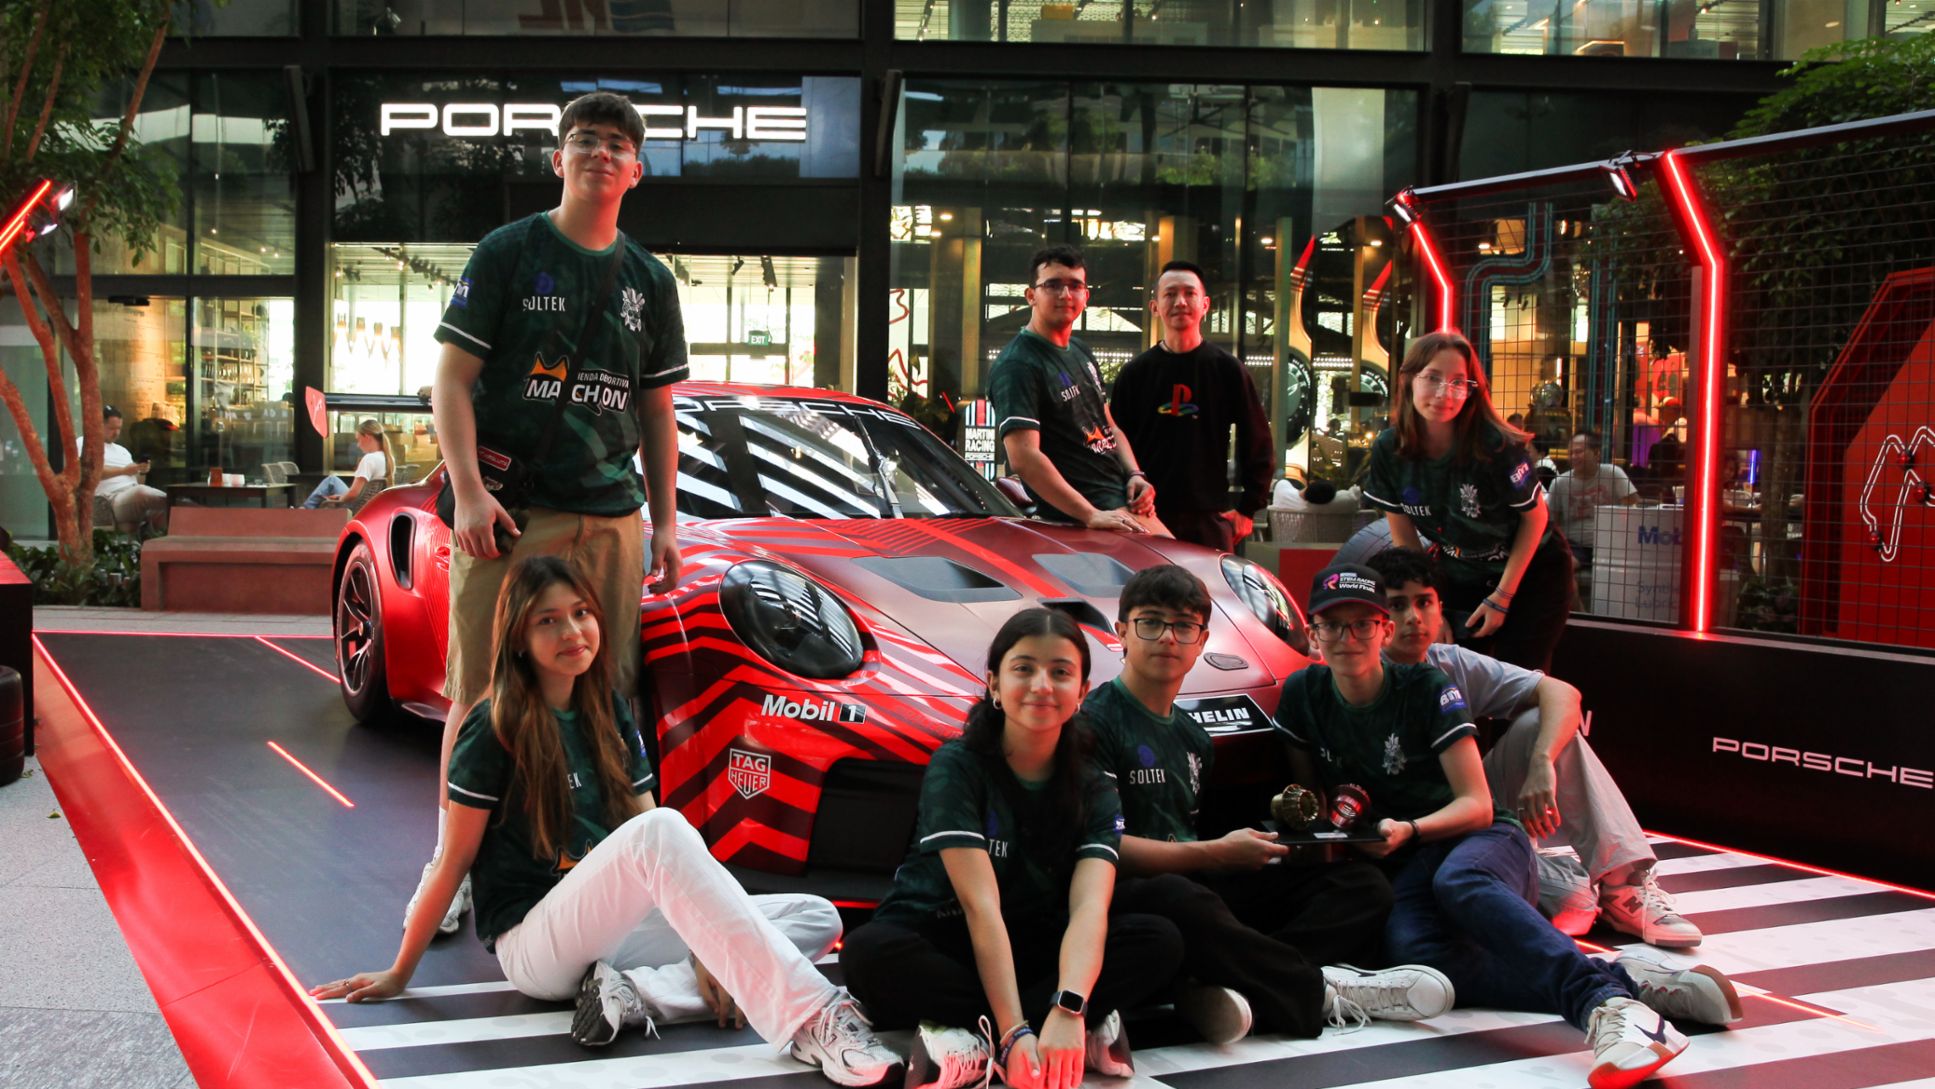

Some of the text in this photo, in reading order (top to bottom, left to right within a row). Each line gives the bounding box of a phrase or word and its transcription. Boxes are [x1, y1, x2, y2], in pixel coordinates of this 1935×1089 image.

[380, 103, 808, 141] PORCHE
[577, 372, 599, 381] IENDA
[672, 396, 921, 430] ORSCHE
[965, 440, 995, 452] RACING
[1638, 526, 1681, 545] Mob
[761, 694, 836, 722] Mobil
[1188, 707, 1250, 724] HELIN
[732, 752, 767, 773] TAG
[1712, 736, 1935, 790] PORSCHE
[730, 770, 767, 794] HEUER
[1129, 768, 1166, 785] SOLTEK
[988, 838, 1009, 858] TEK
